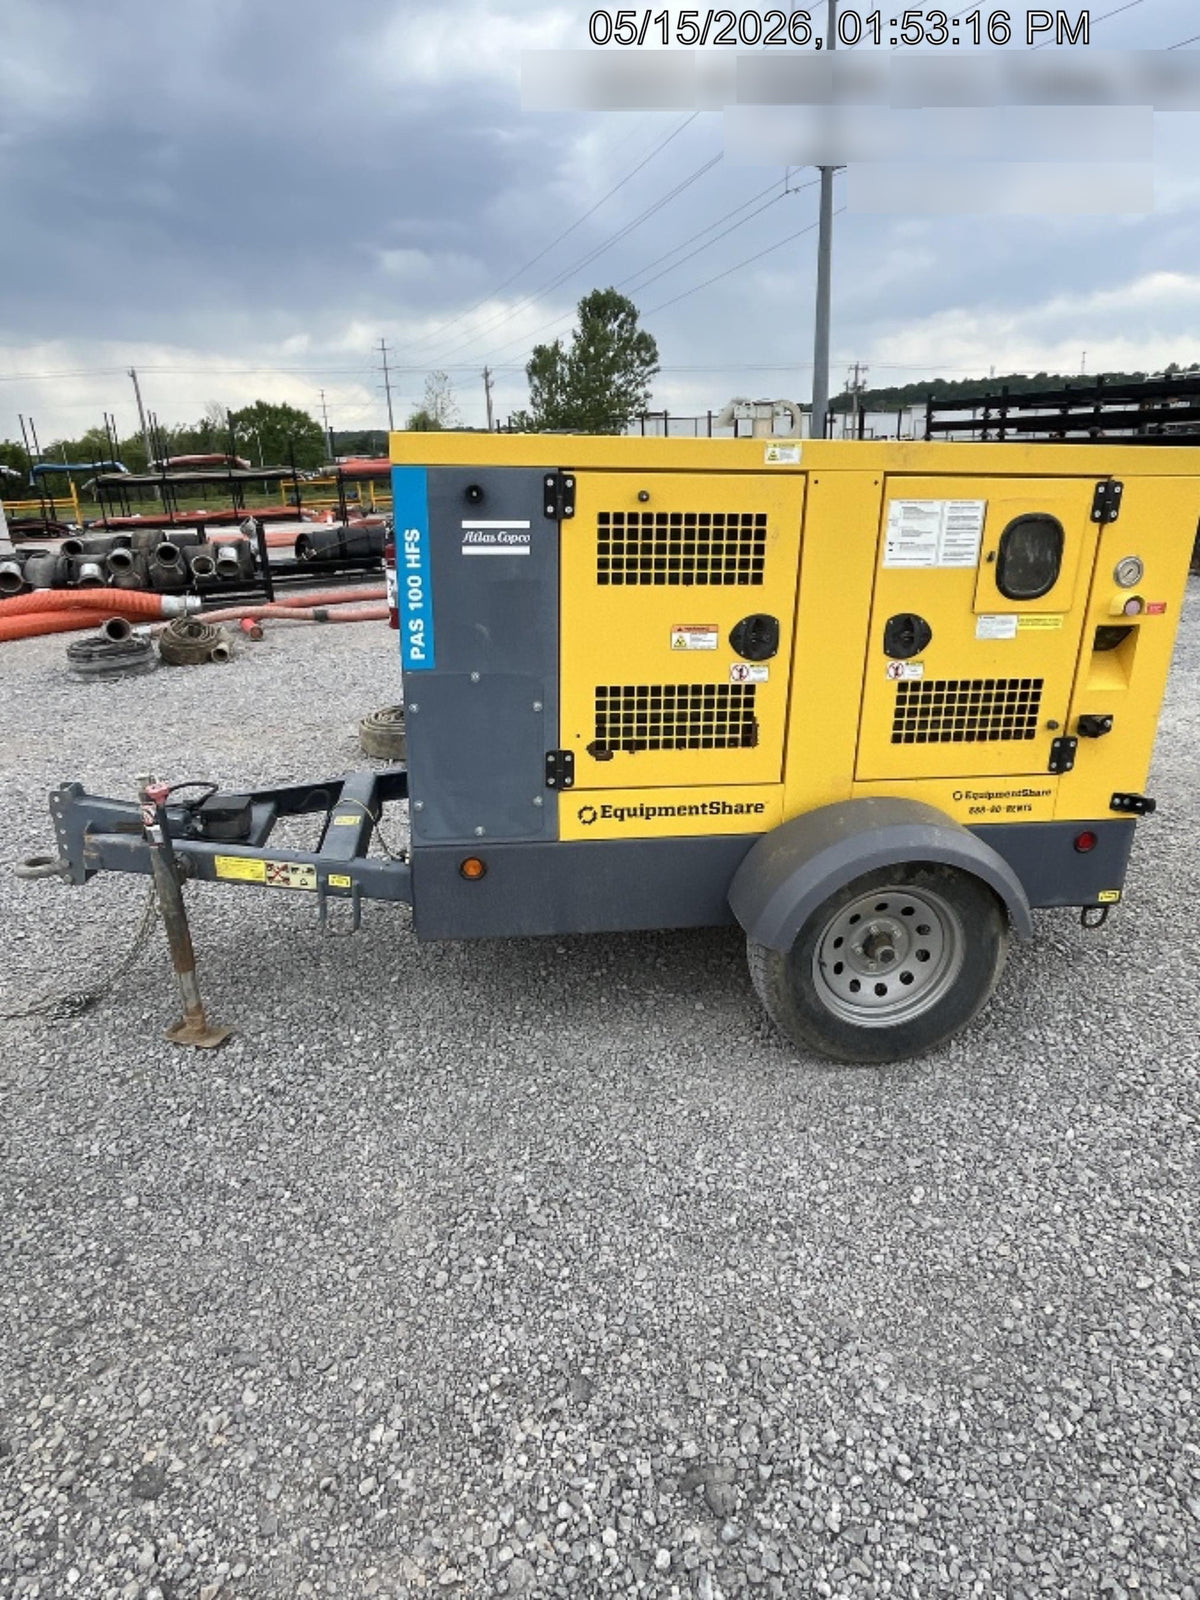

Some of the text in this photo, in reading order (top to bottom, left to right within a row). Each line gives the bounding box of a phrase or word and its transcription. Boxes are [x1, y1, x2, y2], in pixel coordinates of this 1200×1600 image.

[461, 530, 531, 544] Atlas Copco
[404, 528, 426, 661] PAS 100 HFS
[964, 789, 1052, 800] EquipmentShare
[600, 801, 765, 822] EquipmentShare
